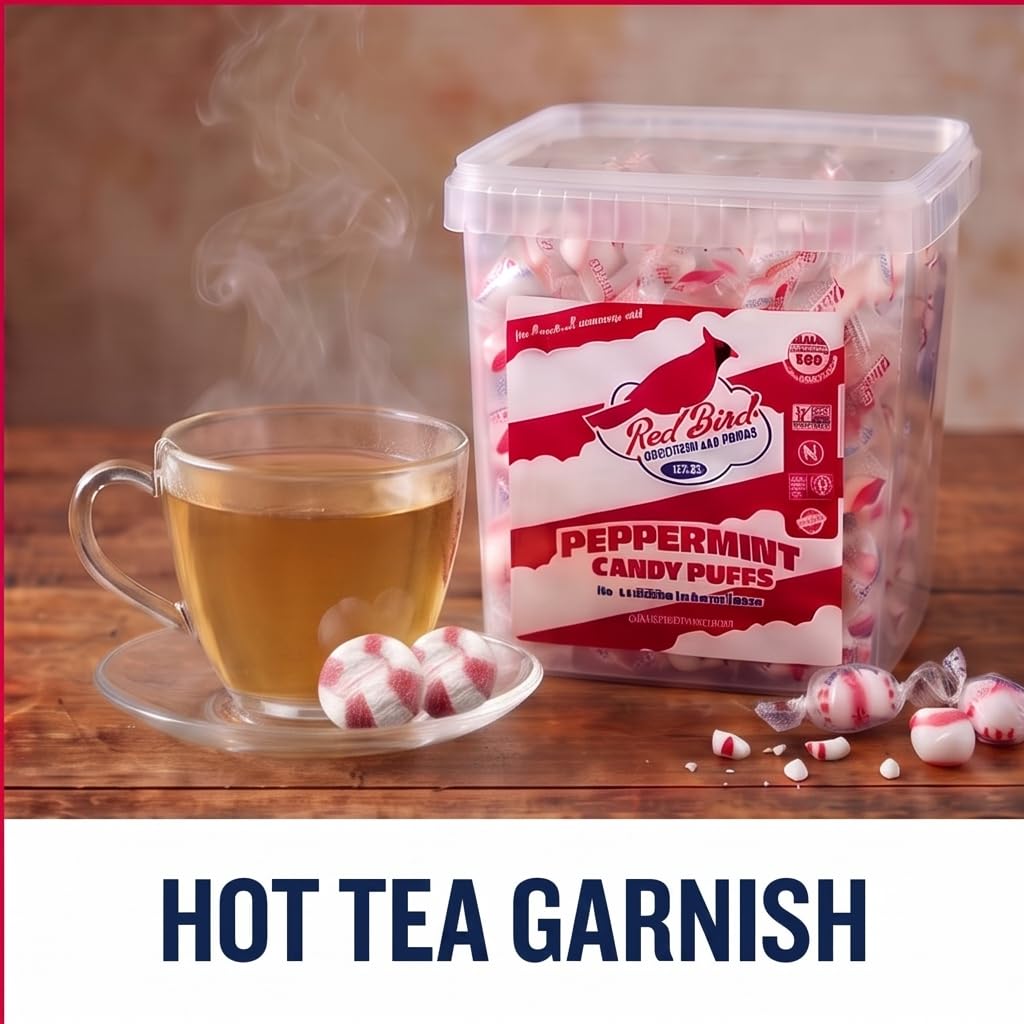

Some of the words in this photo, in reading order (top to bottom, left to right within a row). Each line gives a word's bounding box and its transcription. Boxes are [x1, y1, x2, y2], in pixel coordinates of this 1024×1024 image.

[625, 408, 690, 456] Red
[687, 393, 760, 439] Bird
[561, 525, 800, 572] PEPPERMINT
[591, 557, 683, 582] CANDY
[687, 563, 774, 588] PUFFS
